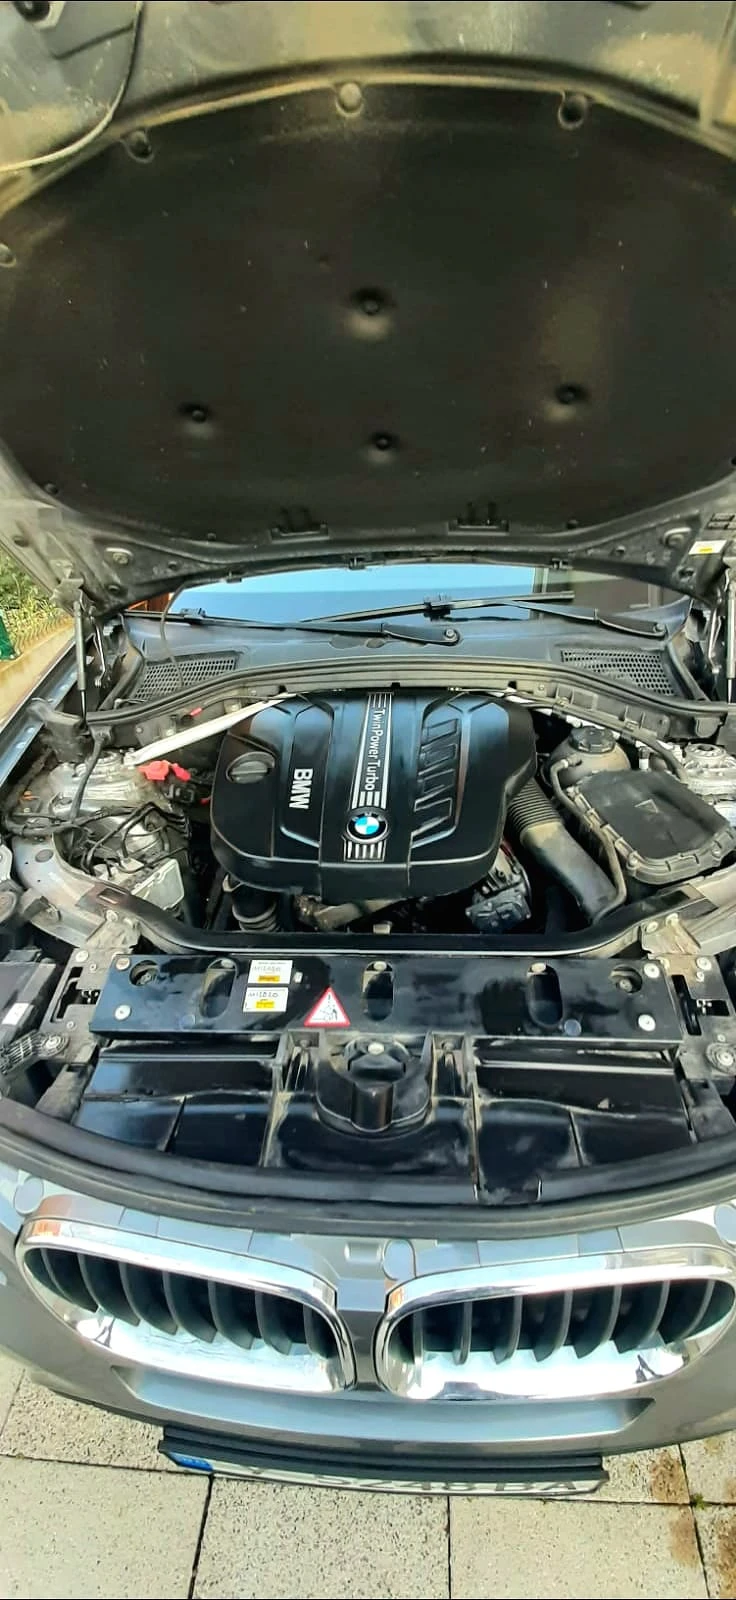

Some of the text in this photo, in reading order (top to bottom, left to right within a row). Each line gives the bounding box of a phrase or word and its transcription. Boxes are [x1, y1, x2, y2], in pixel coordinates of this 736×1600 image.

[368, 708, 386, 759] TwinPower
[289, 768, 313, 809] BMW
[365, 759, 381, 791] Turbo
